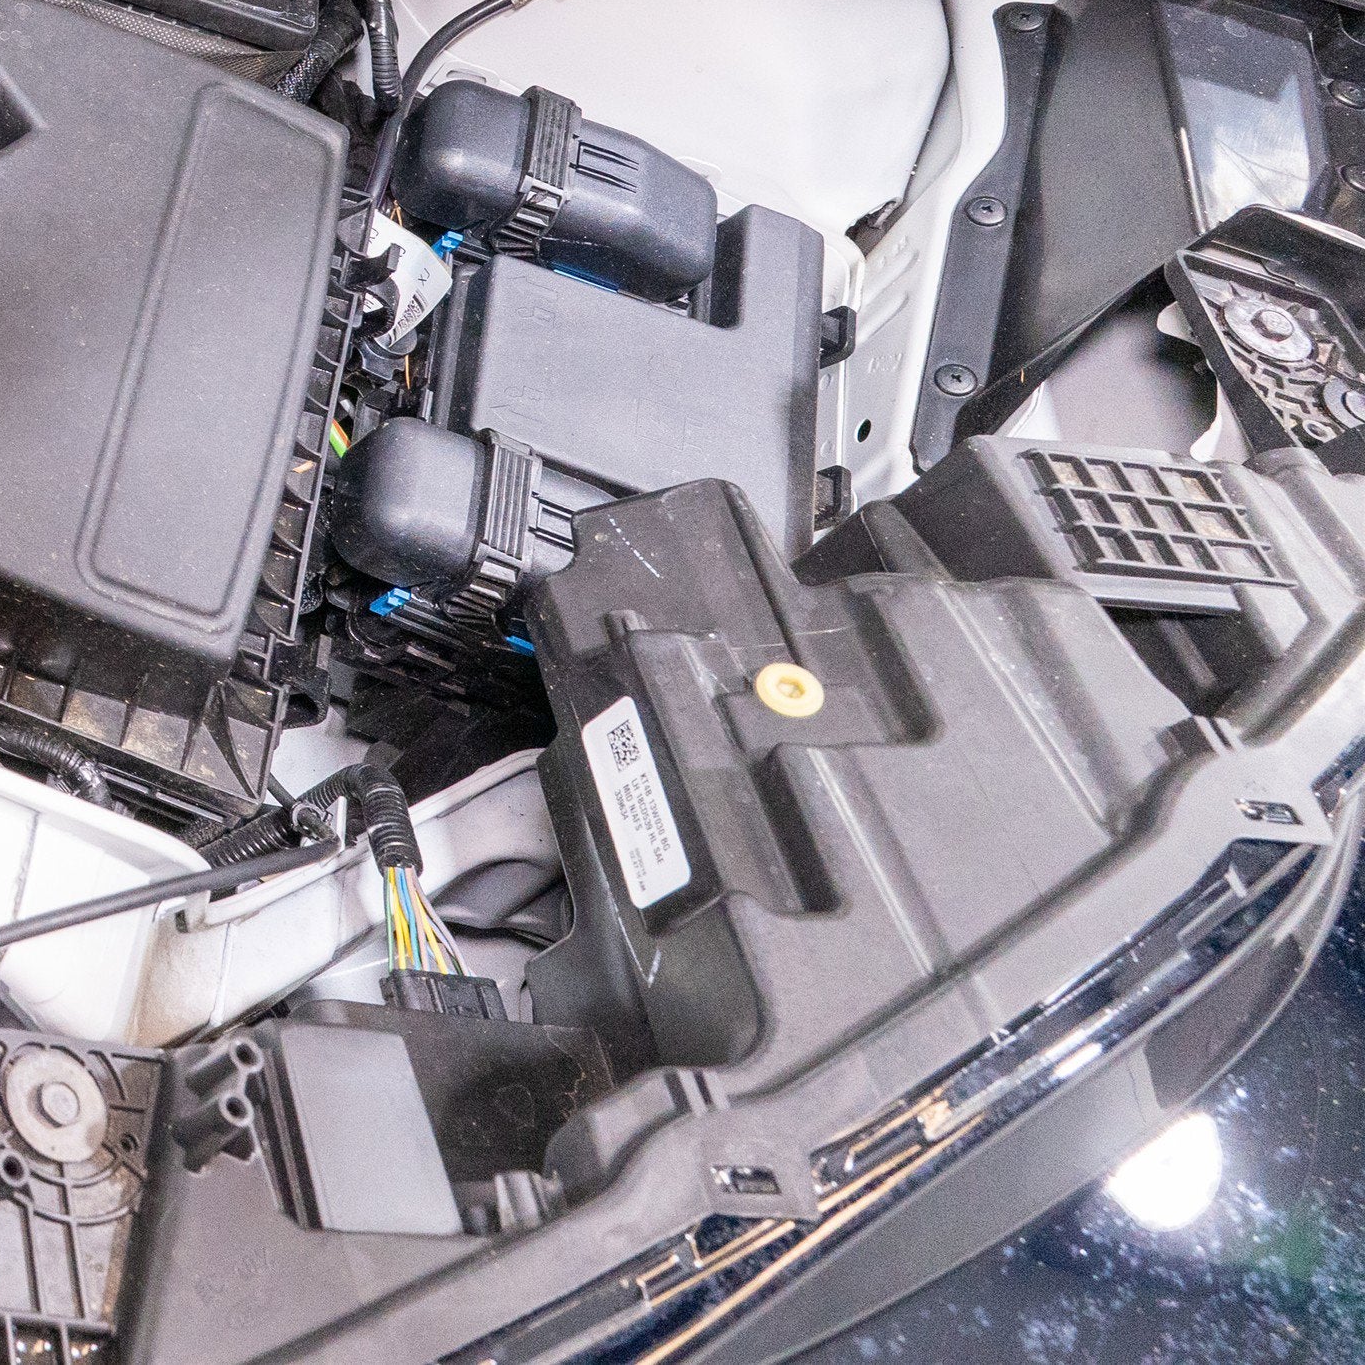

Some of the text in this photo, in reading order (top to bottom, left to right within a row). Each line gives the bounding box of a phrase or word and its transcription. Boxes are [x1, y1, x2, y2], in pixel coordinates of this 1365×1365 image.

[623, 784, 633, 802] MID
[631, 778, 640, 791] LH
[648, 833, 657, 845] HL
[653, 847, 665, 865] SAE
[640, 773, 671, 852] KT4B 13W030 BG
